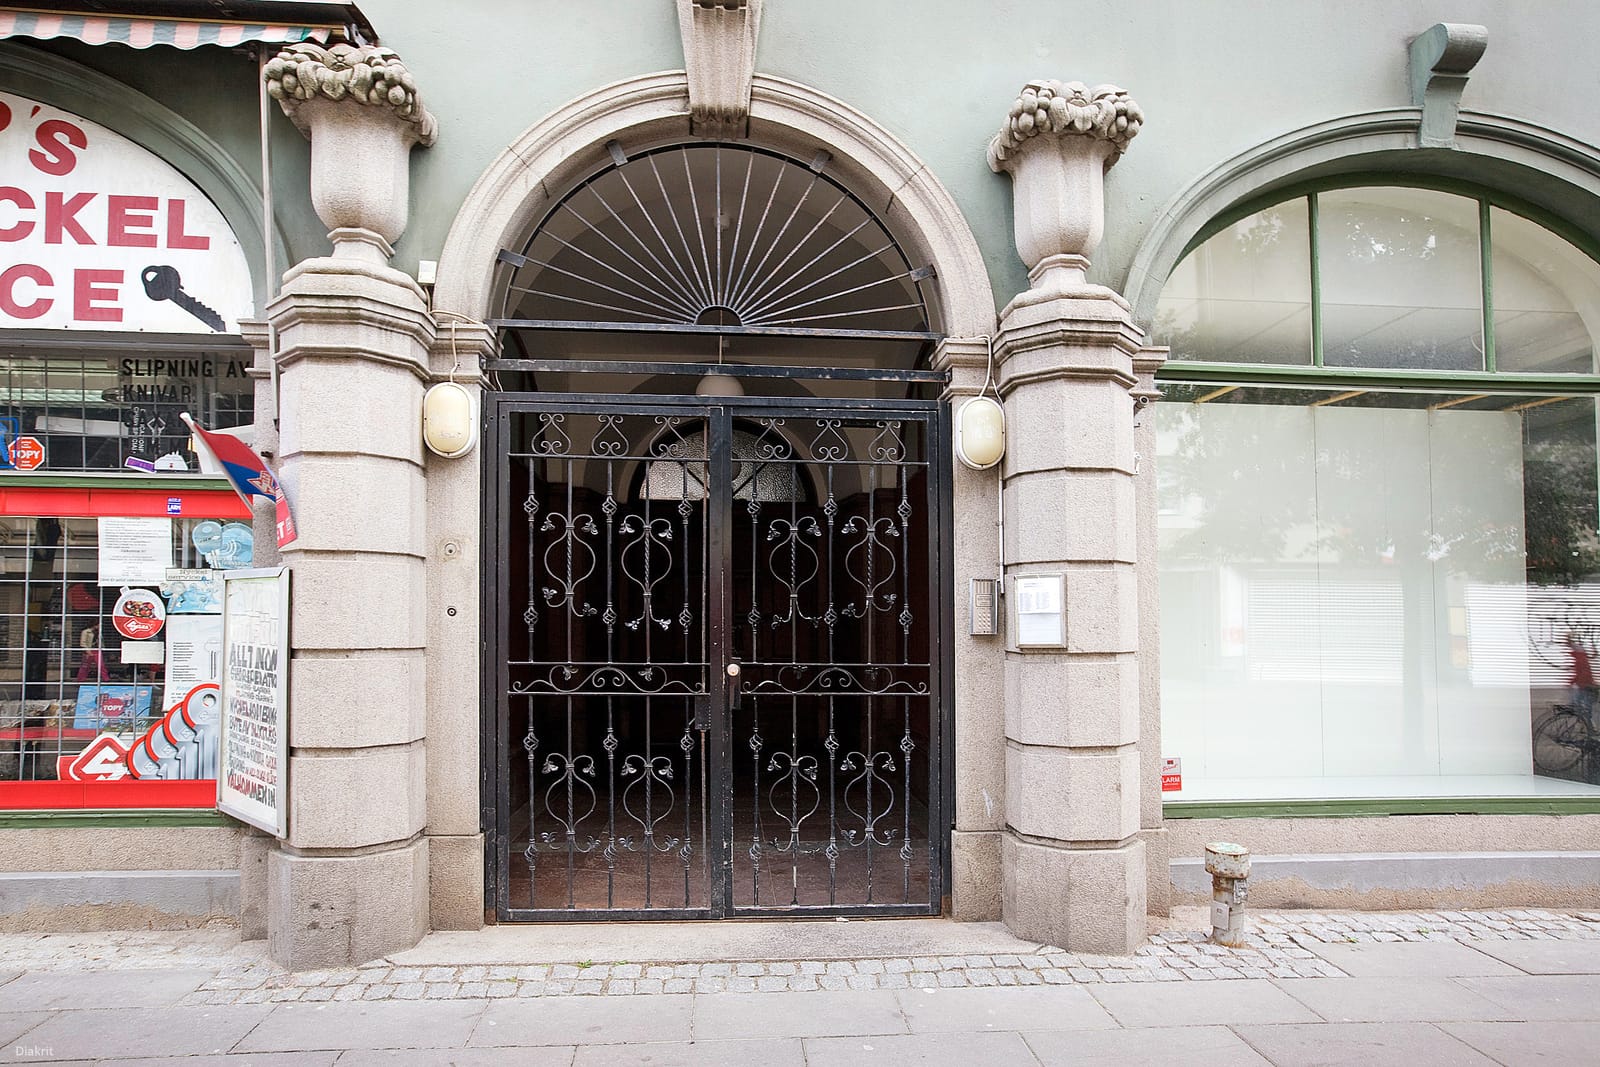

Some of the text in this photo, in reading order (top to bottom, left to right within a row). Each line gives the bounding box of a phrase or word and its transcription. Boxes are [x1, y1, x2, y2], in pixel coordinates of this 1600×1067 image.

[0, 102, 88, 176] 'S
[0, 264, 124, 322] CE
[122, 358, 213, 378] SLIPNING
[103, 704, 123, 712] TOPY
[1162, 775, 1180, 784] LARM
